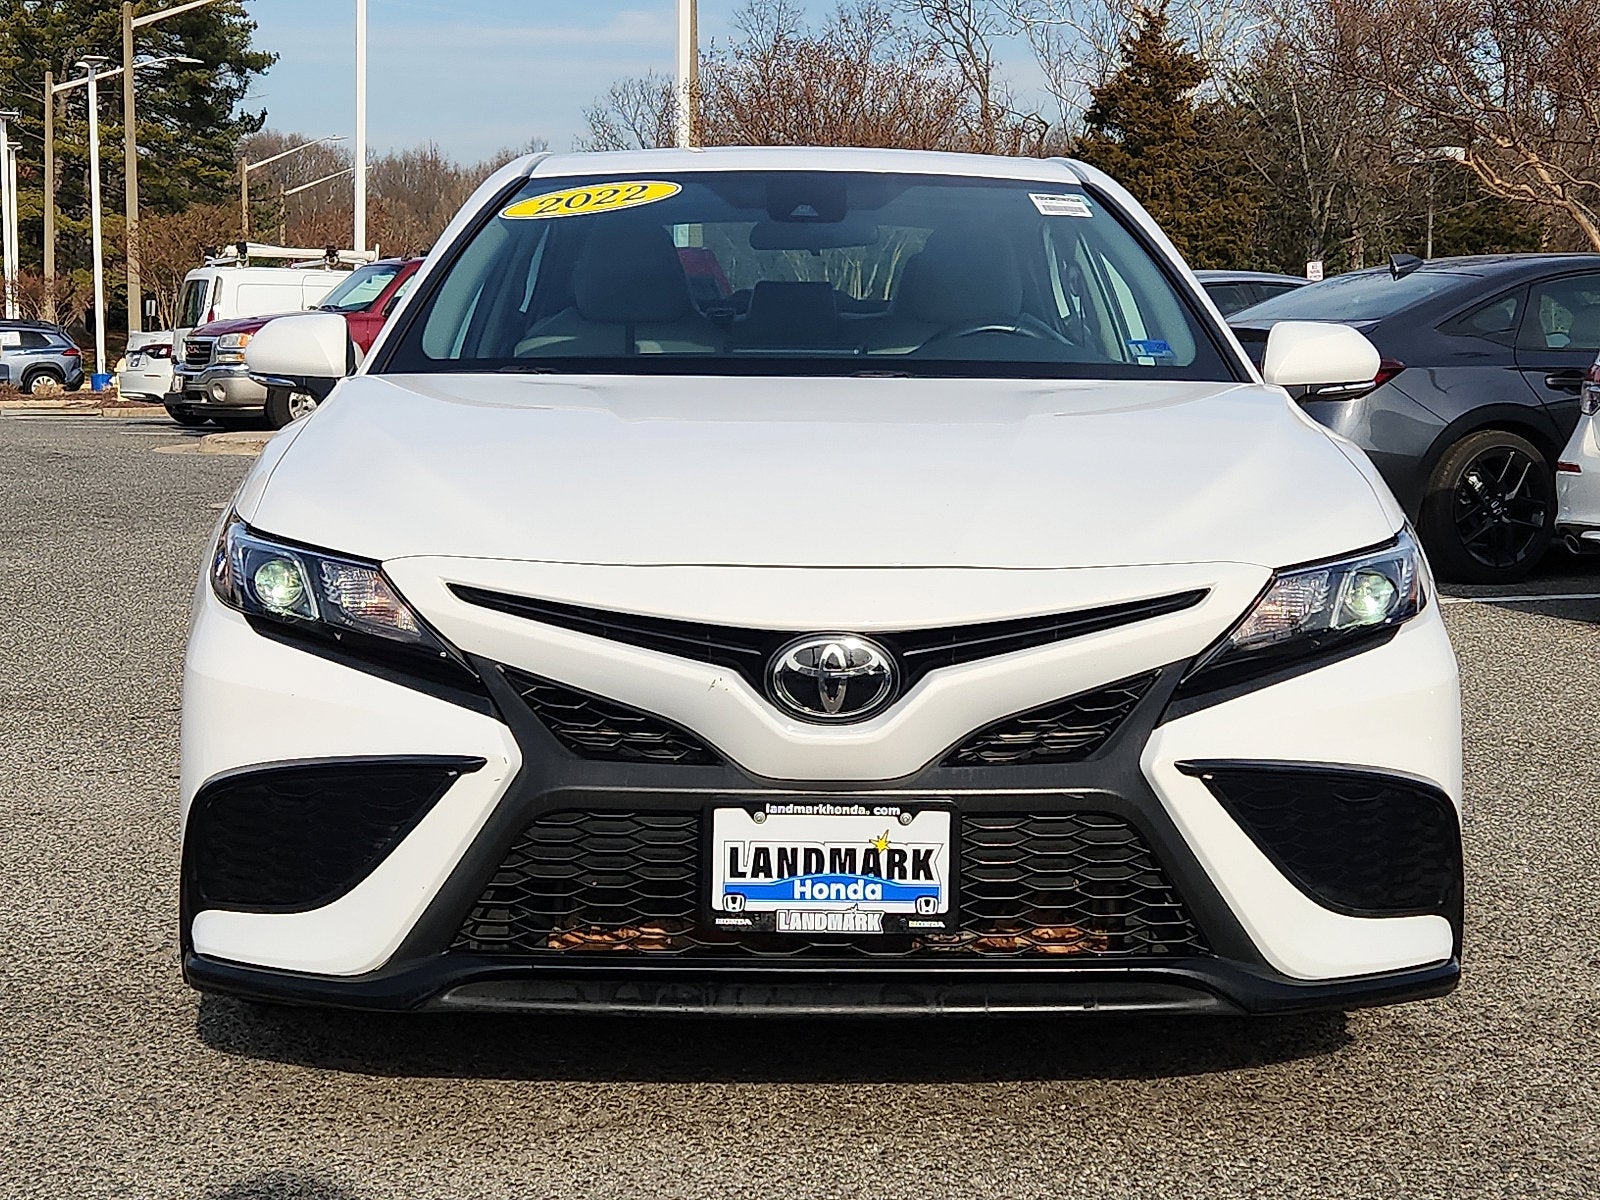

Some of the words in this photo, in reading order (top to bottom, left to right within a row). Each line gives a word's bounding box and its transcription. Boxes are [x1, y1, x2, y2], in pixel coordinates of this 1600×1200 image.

[533, 185, 649, 215] 2022
[729, 846, 935, 881] LANDMARK
[794, 879, 883, 901] Honda
[778, 911, 883, 932] LANDMARK
